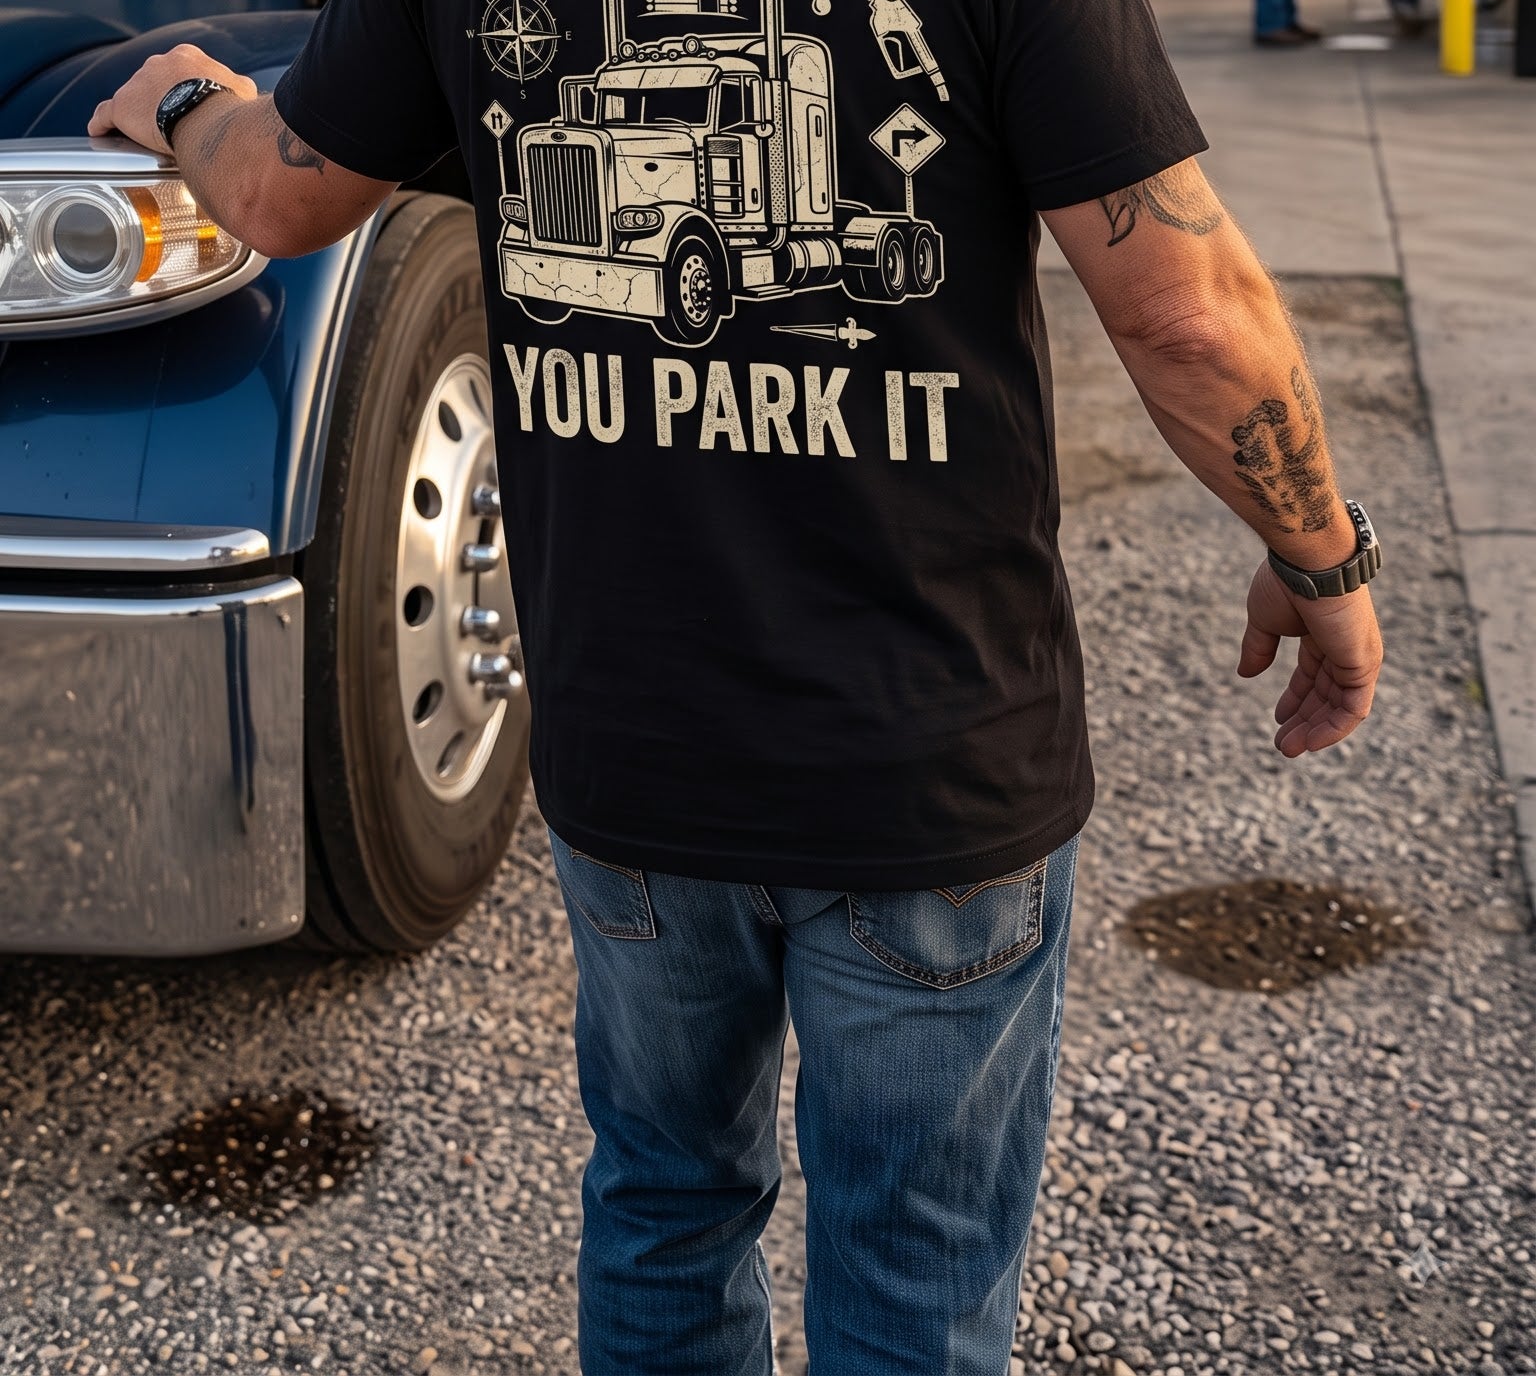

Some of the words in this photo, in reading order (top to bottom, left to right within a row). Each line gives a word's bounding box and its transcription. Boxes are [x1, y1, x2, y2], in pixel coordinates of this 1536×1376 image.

[465, 29, 475, 39] W
[565, 30, 573, 41] E
[519, 89, 527, 100] S
[502, 343, 625, 444] YOU
[652, 357, 857, 458] PARK
[884, 370, 960, 462] IT
